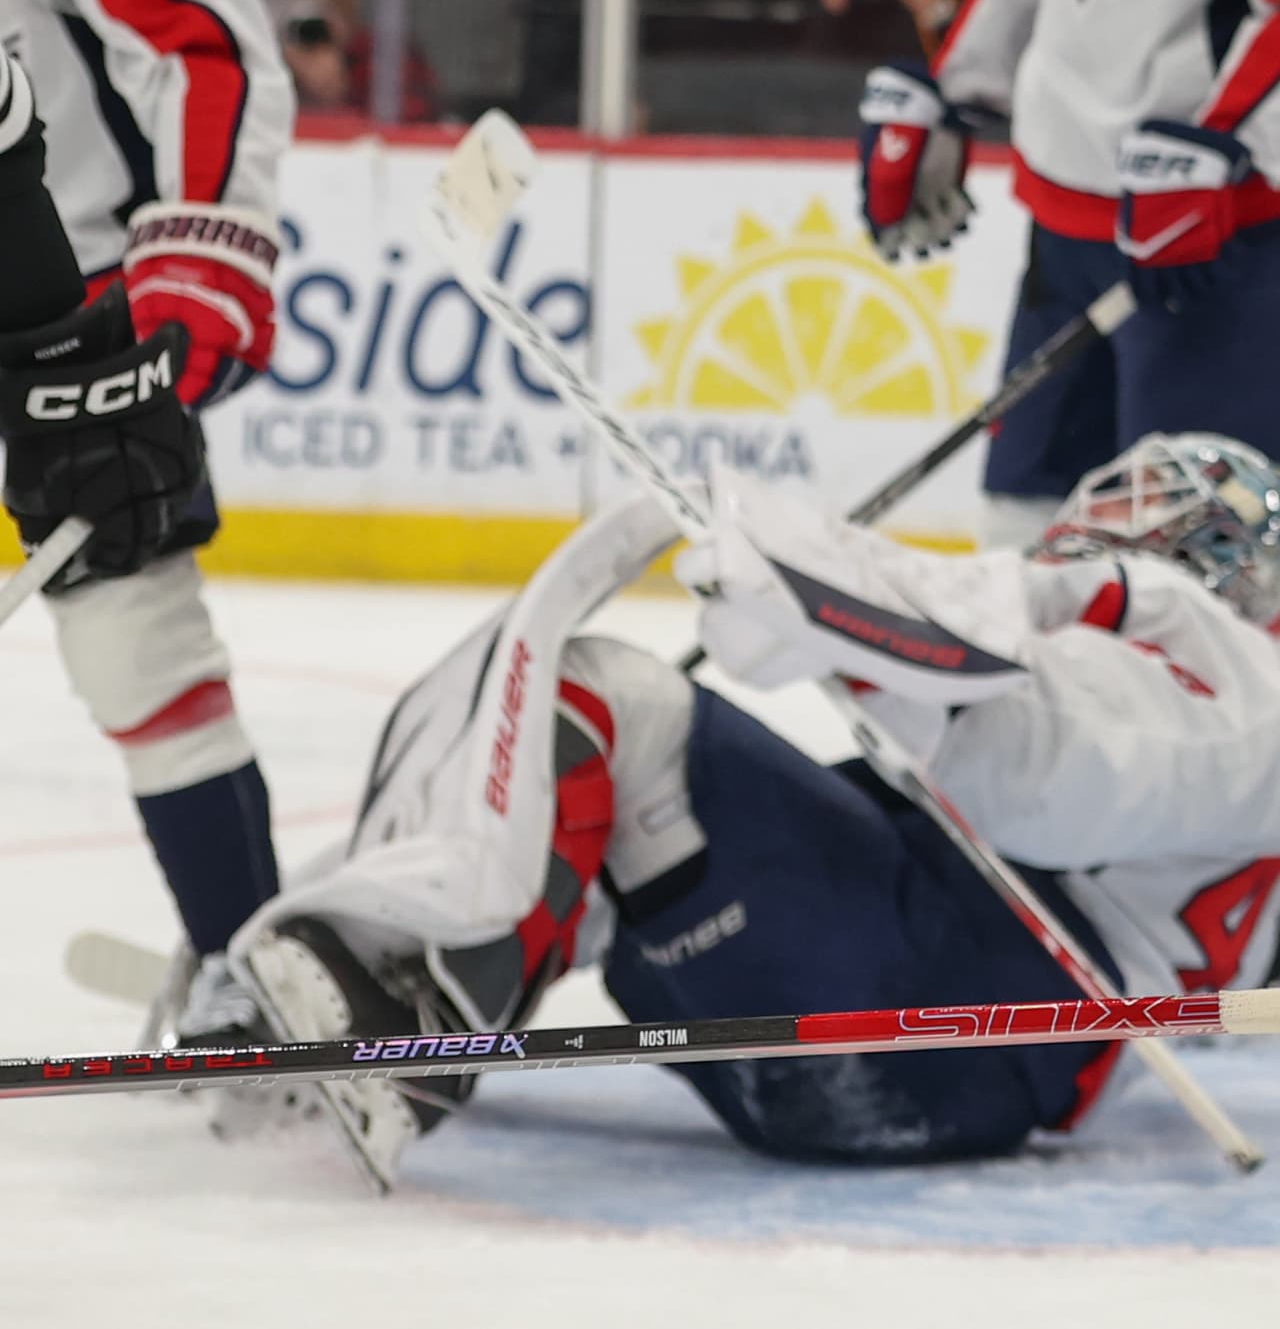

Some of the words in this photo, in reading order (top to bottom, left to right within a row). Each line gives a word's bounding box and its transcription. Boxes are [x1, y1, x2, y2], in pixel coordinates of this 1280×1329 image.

[26, 351, 172, 420] CCM
[244, 409, 382, 471] ICED
[414, 415, 528, 473] TEA
[639, 1028, 688, 1048] WILSON
